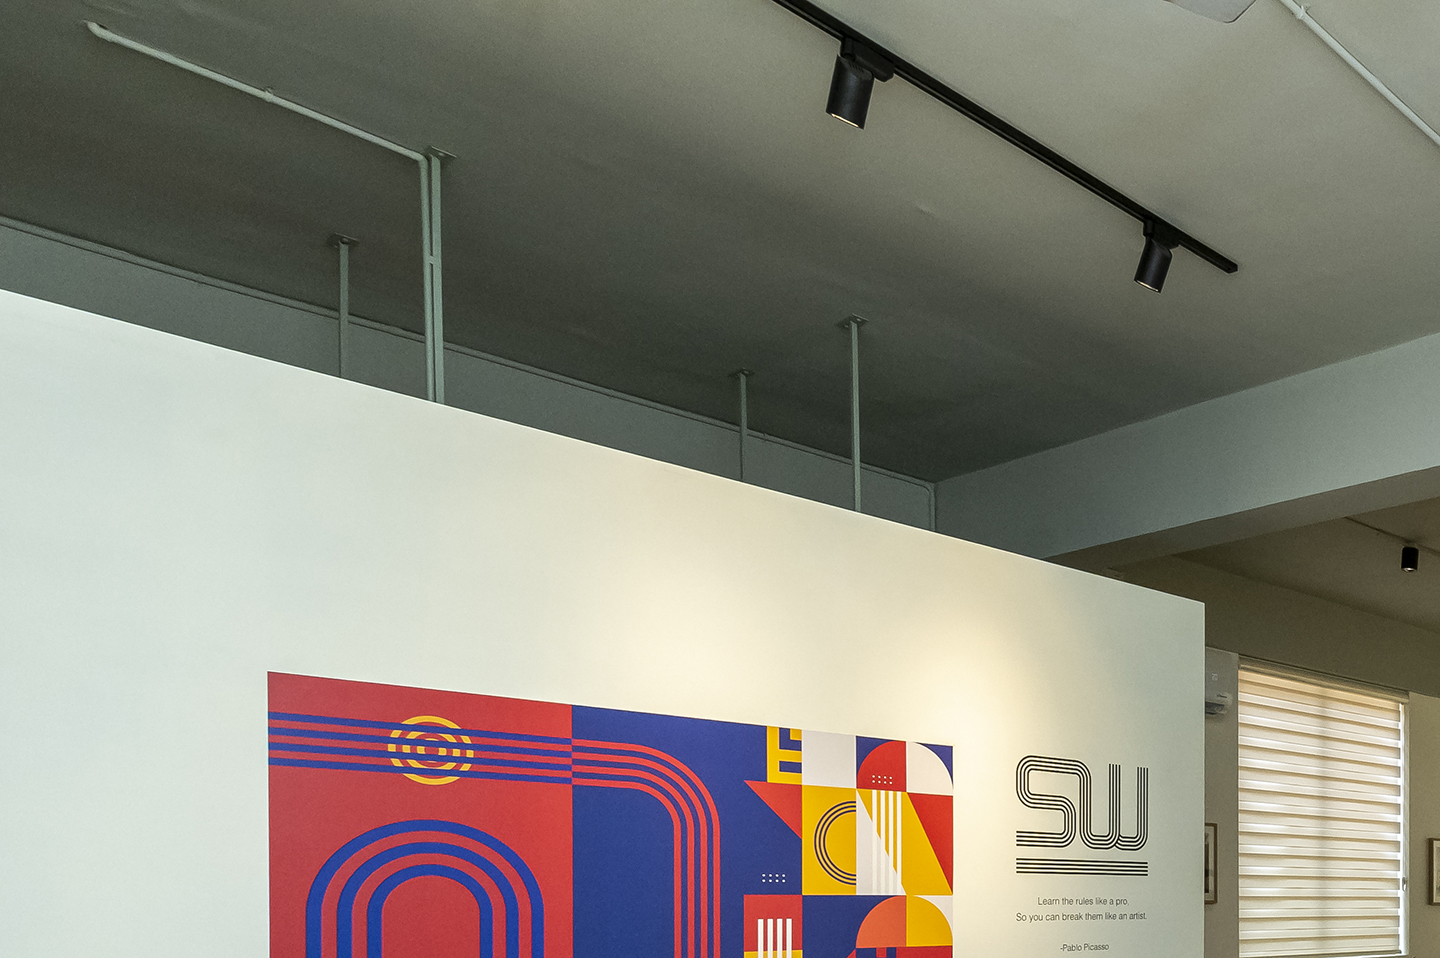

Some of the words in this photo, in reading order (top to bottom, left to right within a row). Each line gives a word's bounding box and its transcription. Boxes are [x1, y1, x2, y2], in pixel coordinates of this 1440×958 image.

[1015, 754, 1149, 851] SW
[1037, 896, 1060, 906] Learn
[1061, 897, 1074, 905] the
[1075, 897, 1094, 906] rules
[1095, 897, 1108, 905] like
[1109, 898, 1114, 906] a
[1015, 912, 1027, 922] So
[1029, 914, 1044, 923] you
[1045, 913, 1060, 921] can
[1061, 912, 1084, 921] break
[1085, 912, 1104, 921] them
[1104, 912, 1117, 921] like
[1118, 912, 1128, 920] an
[1129, 912, 1148, 920] artist.
[1060, 944, 1083, 952] -Pablo
[1083, 943, 1110, 951] Picasso
